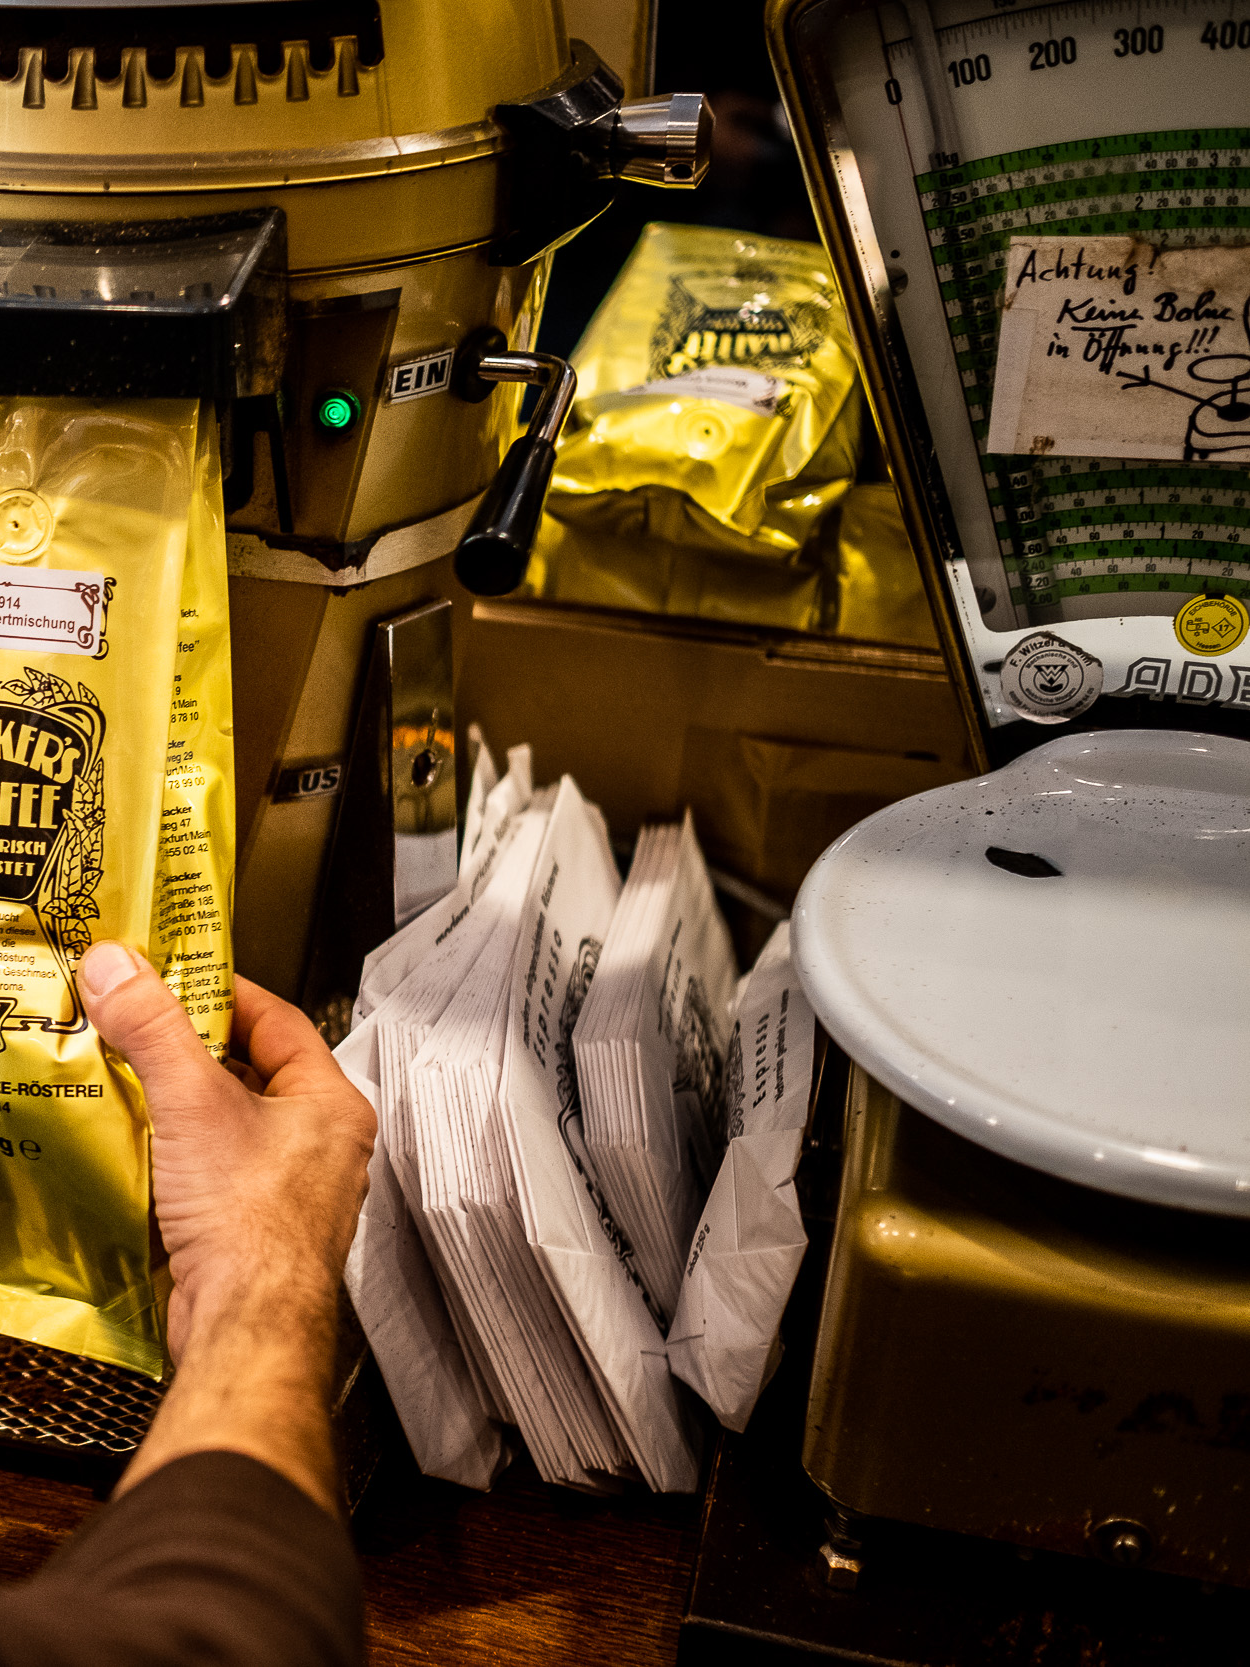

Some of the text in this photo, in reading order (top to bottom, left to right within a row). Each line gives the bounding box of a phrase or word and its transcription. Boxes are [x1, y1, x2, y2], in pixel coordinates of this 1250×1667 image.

[884, 20, 1250, 105] 0 100 200 300 400
[1092, 142, 1100, 158] 2
[1191, 133, 1200, 149] 3
[1145, 159, 1157, 169] 40
[1166, 158, 1178, 168] 60
[1210, 152, 1219, 168] 3
[1229, 156, 1241, 166] 20
[1228, 173, 1238, 188] 3
[1135, 196, 1144, 211] 2
[1153, 214, 1162, 229] 2
[1016, 246, 1161, 296] Achtung!
[1056, 297, 1145, 325] Keine
[1047, 332, 1070, 358] in
[395, 358, 448, 394] EIN
[1056, 535, 1067, 545] 40
[1123, 528, 1134, 538] 80
[1192, 530, 1204, 540] 20
[1227, 532, 1240, 543] 40
[1071, 566, 1082, 576] 40
[1107, 564, 1118, 574] 60
[1145, 563, 1156, 573] 80
[1222, 567, 1234, 577] 20
[1189, 600, 1238, 617] EICHBEHÖRDE
[1218, 624, 1230, 632] 17
[1019, 639, 1055, 656] Witzel
[1196, 641, 1222, 650] Hessen
[175, 686, 181, 695] 9
[178, 712, 188, 722] 78
[190, 711, 199, 721] 10
[183, 751, 194, 761] 29
[195, 776, 205, 786] 00
[162, 806, 192, 817] acker
[179, 818, 191, 828] 47
[183, 845, 195, 855] 02
[197, 843, 209, 852] 42
[164, 871, 202, 885] acker
[5, 926, 36, 936] dieses
[184, 925, 196, 936] 00
[198, 924, 209, 934] 77
[211, 921, 222, 932] 52
[2, 938, 16, 948] die
[174, 950, 214, 962] Wacker
[3, 967, 58, 979] Geschmack
[214, 976, 220, 985] 2
[533, 928, 563, 1070] Espresso
